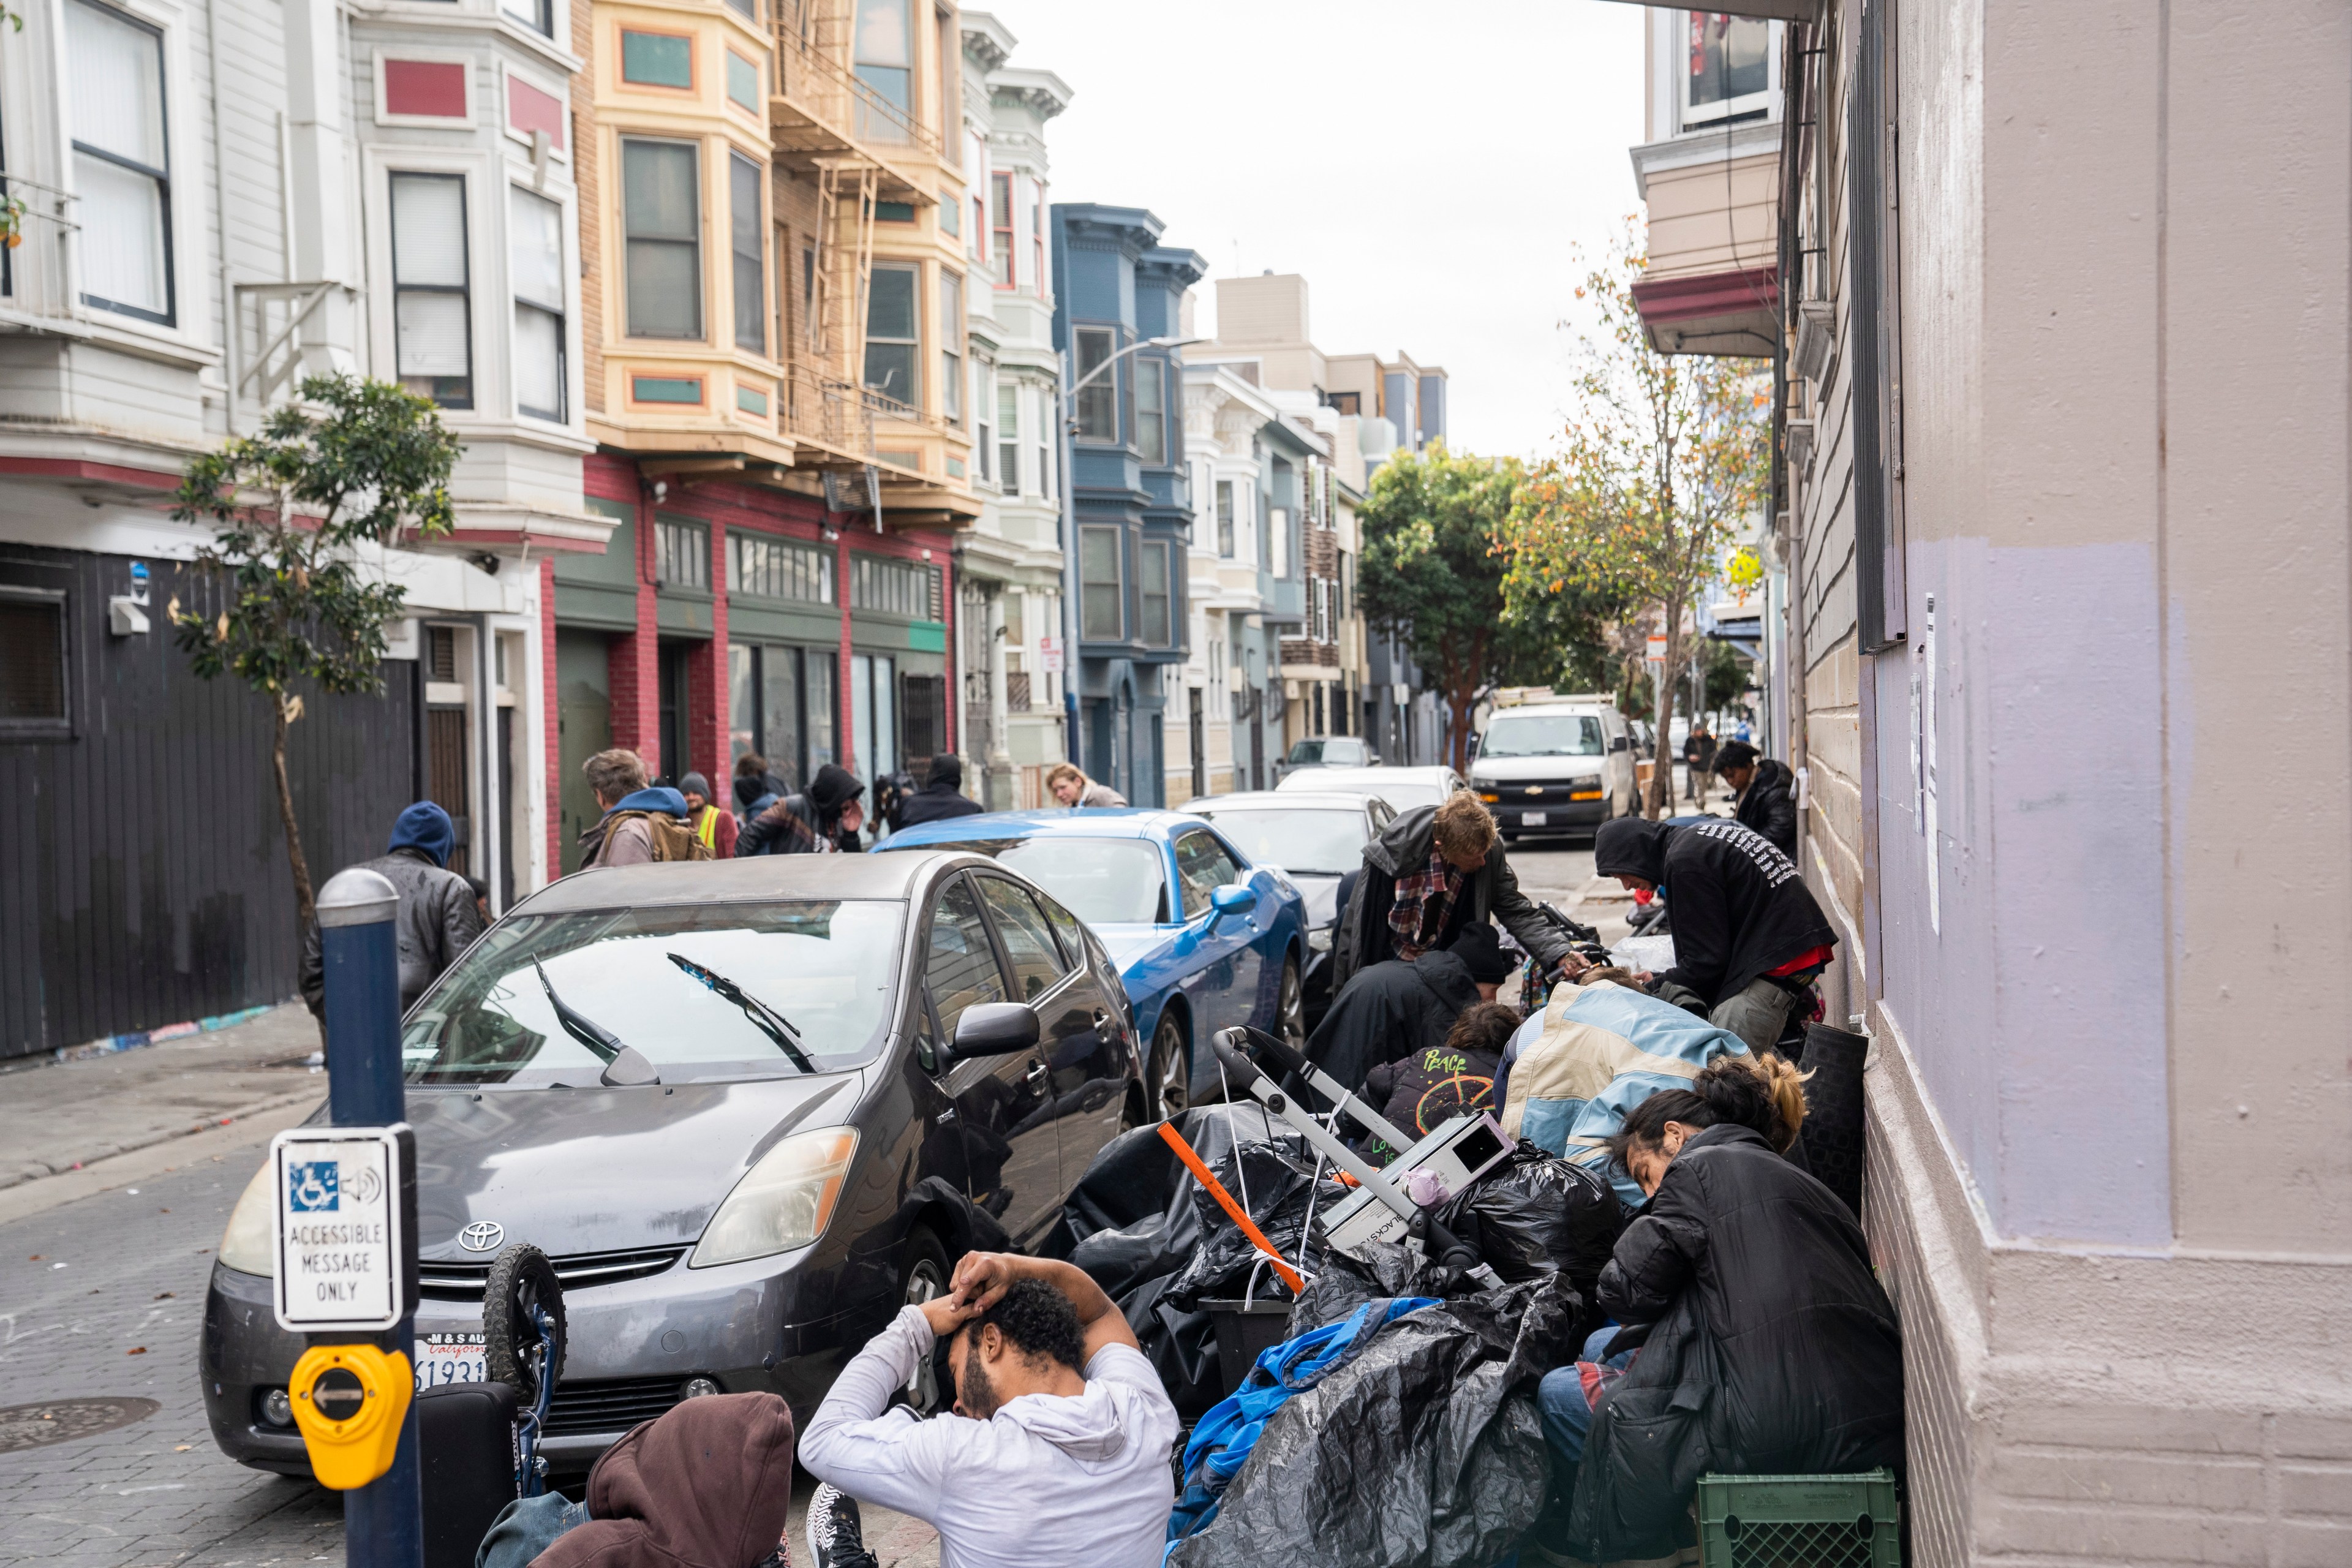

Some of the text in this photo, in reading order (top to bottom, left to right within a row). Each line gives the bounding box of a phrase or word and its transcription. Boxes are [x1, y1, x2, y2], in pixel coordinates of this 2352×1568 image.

[1754, 851, 1770, 865] hood
[1760, 860, 1774, 872] have
[1767, 867, 1781, 880] down
[1779, 862, 1788, 871] the
[1423, 1049, 1467, 1073] PEACE
[290, 1225, 382, 1246] ACCESSIBLE
[302, 1253, 371, 1273] MESSAGE
[317, 1282, 357, 1302] ONLY
[431, 1334, 441, 1344] M
[445, 1333, 453, 1344] &
[457, 1333, 466, 1344] S
